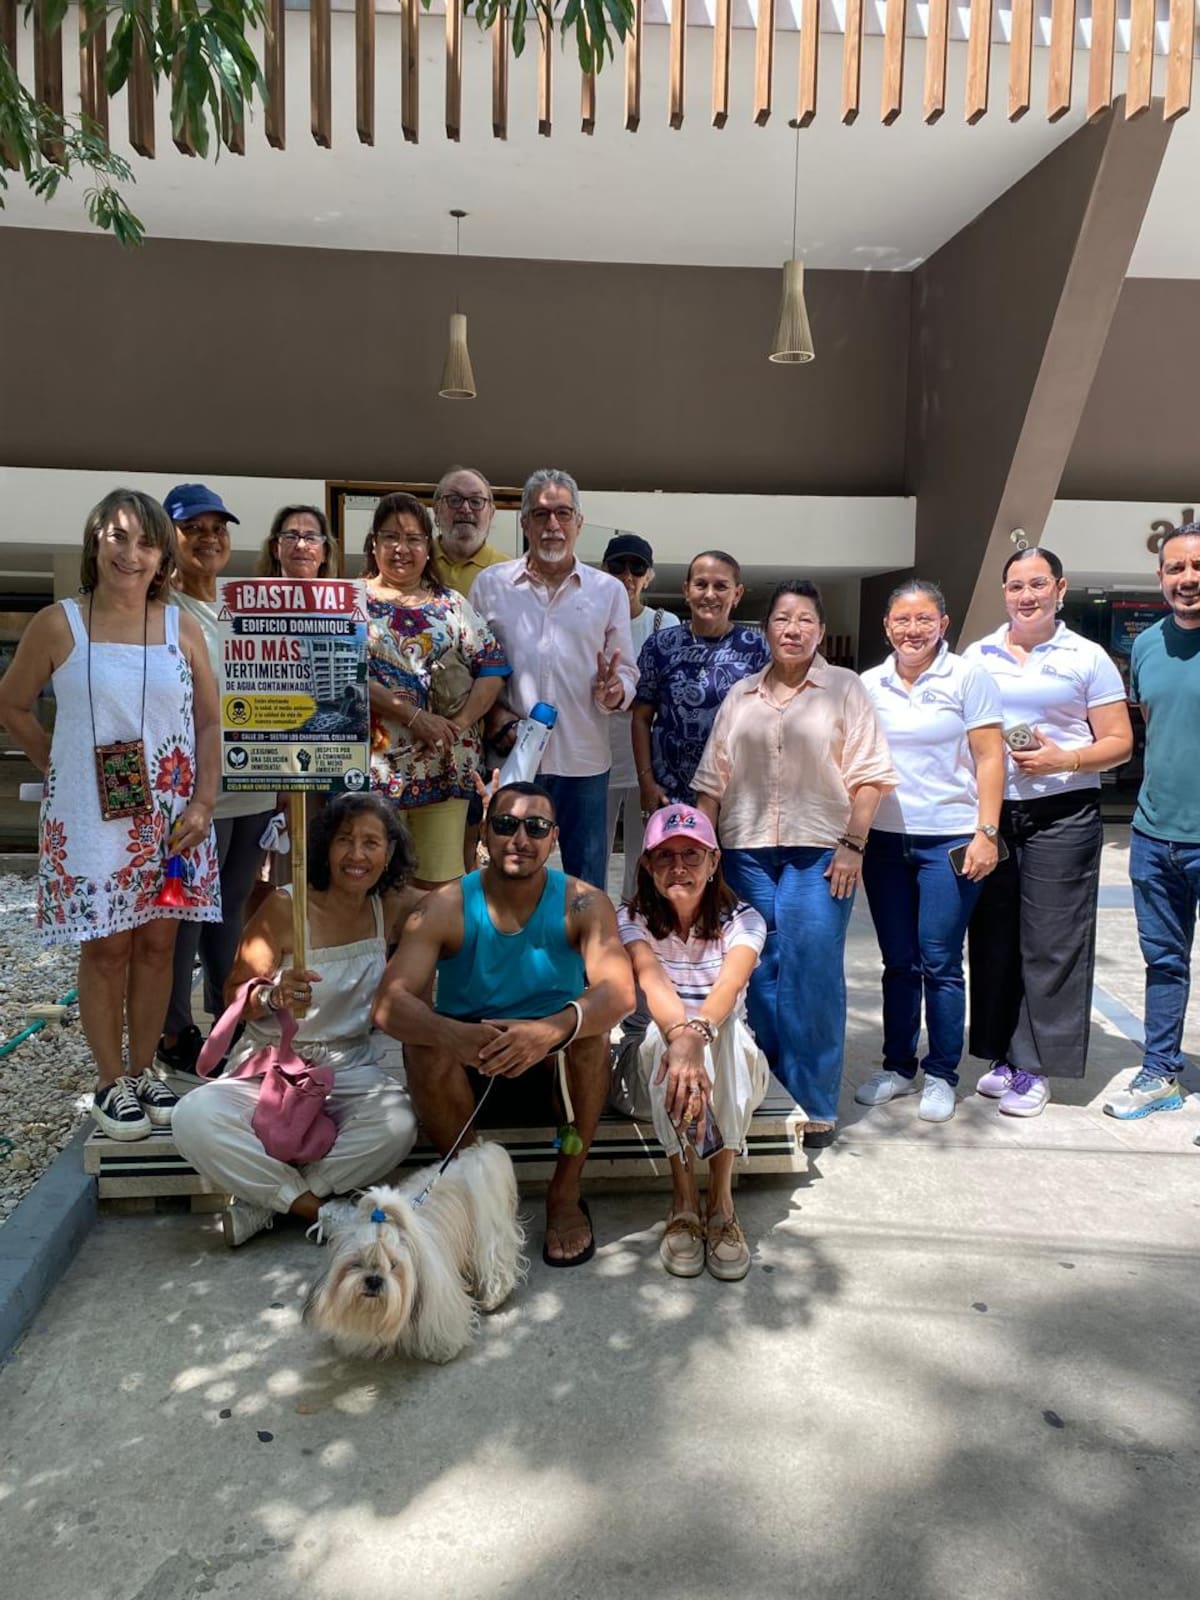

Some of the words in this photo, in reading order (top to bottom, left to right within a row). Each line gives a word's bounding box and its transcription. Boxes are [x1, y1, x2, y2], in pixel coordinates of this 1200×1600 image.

[235, 585, 306, 610] ¡BASTA
[311, 586, 345, 610] YA!
[241, 619, 287, 633] EDIFICIO
[290, 620, 350, 635] DOMINIQUE
[224, 640, 255, 661] ¡NO
[261, 636, 301, 661] MÁS
[224, 663, 311, 679] VERTIMIENTOS
[225, 681, 235, 691] DE
[236, 681, 256, 691] AGUA
